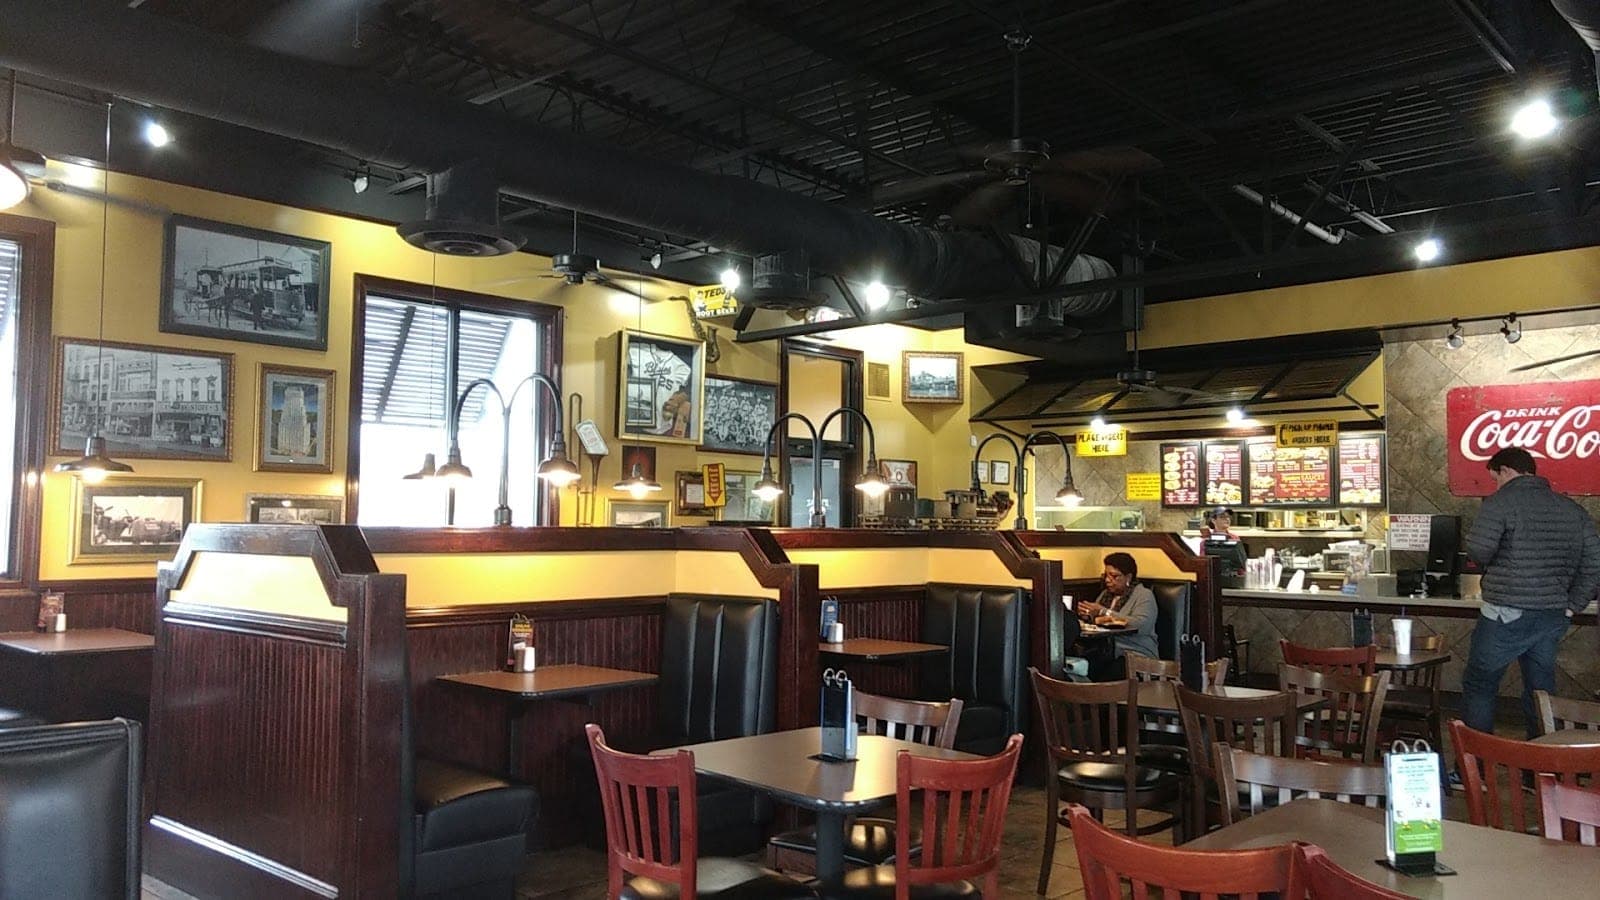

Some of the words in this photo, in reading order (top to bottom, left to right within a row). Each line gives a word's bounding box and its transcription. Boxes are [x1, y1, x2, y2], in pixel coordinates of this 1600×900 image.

[658, 375, 674, 391] 25
[1504, 406, 1562, 417] DRINK
[1079, 433, 1099, 442] PLACE
[1460, 405, 1600, 461] Coca-Co
[1092, 445, 1108, 453] HERE
[1396, 515, 1431, 523] WARNIN
